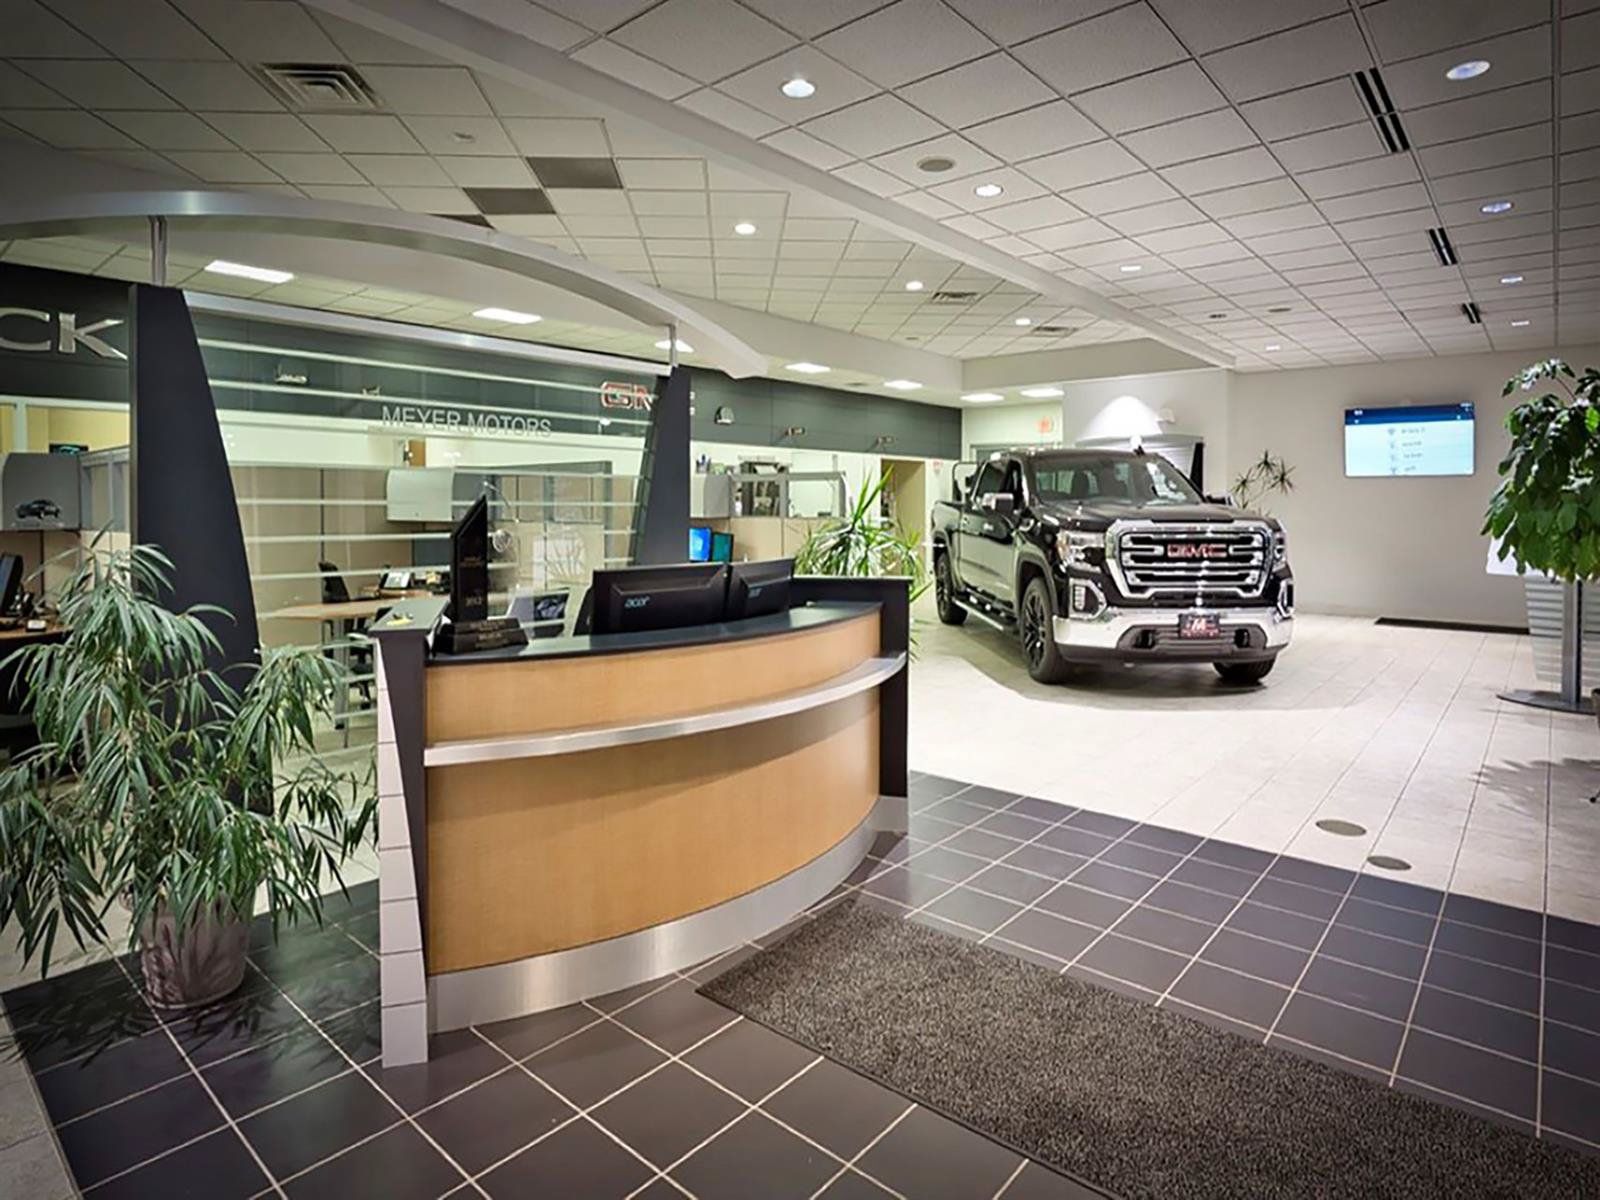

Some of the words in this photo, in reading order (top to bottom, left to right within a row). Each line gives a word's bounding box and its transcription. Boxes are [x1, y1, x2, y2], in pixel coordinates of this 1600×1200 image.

[382, 405, 461, 431] MEYER
[467, 412, 552, 438] MOTORS
[1167, 543, 1227, 558] GMC
[624, 596, 651, 609] acer
